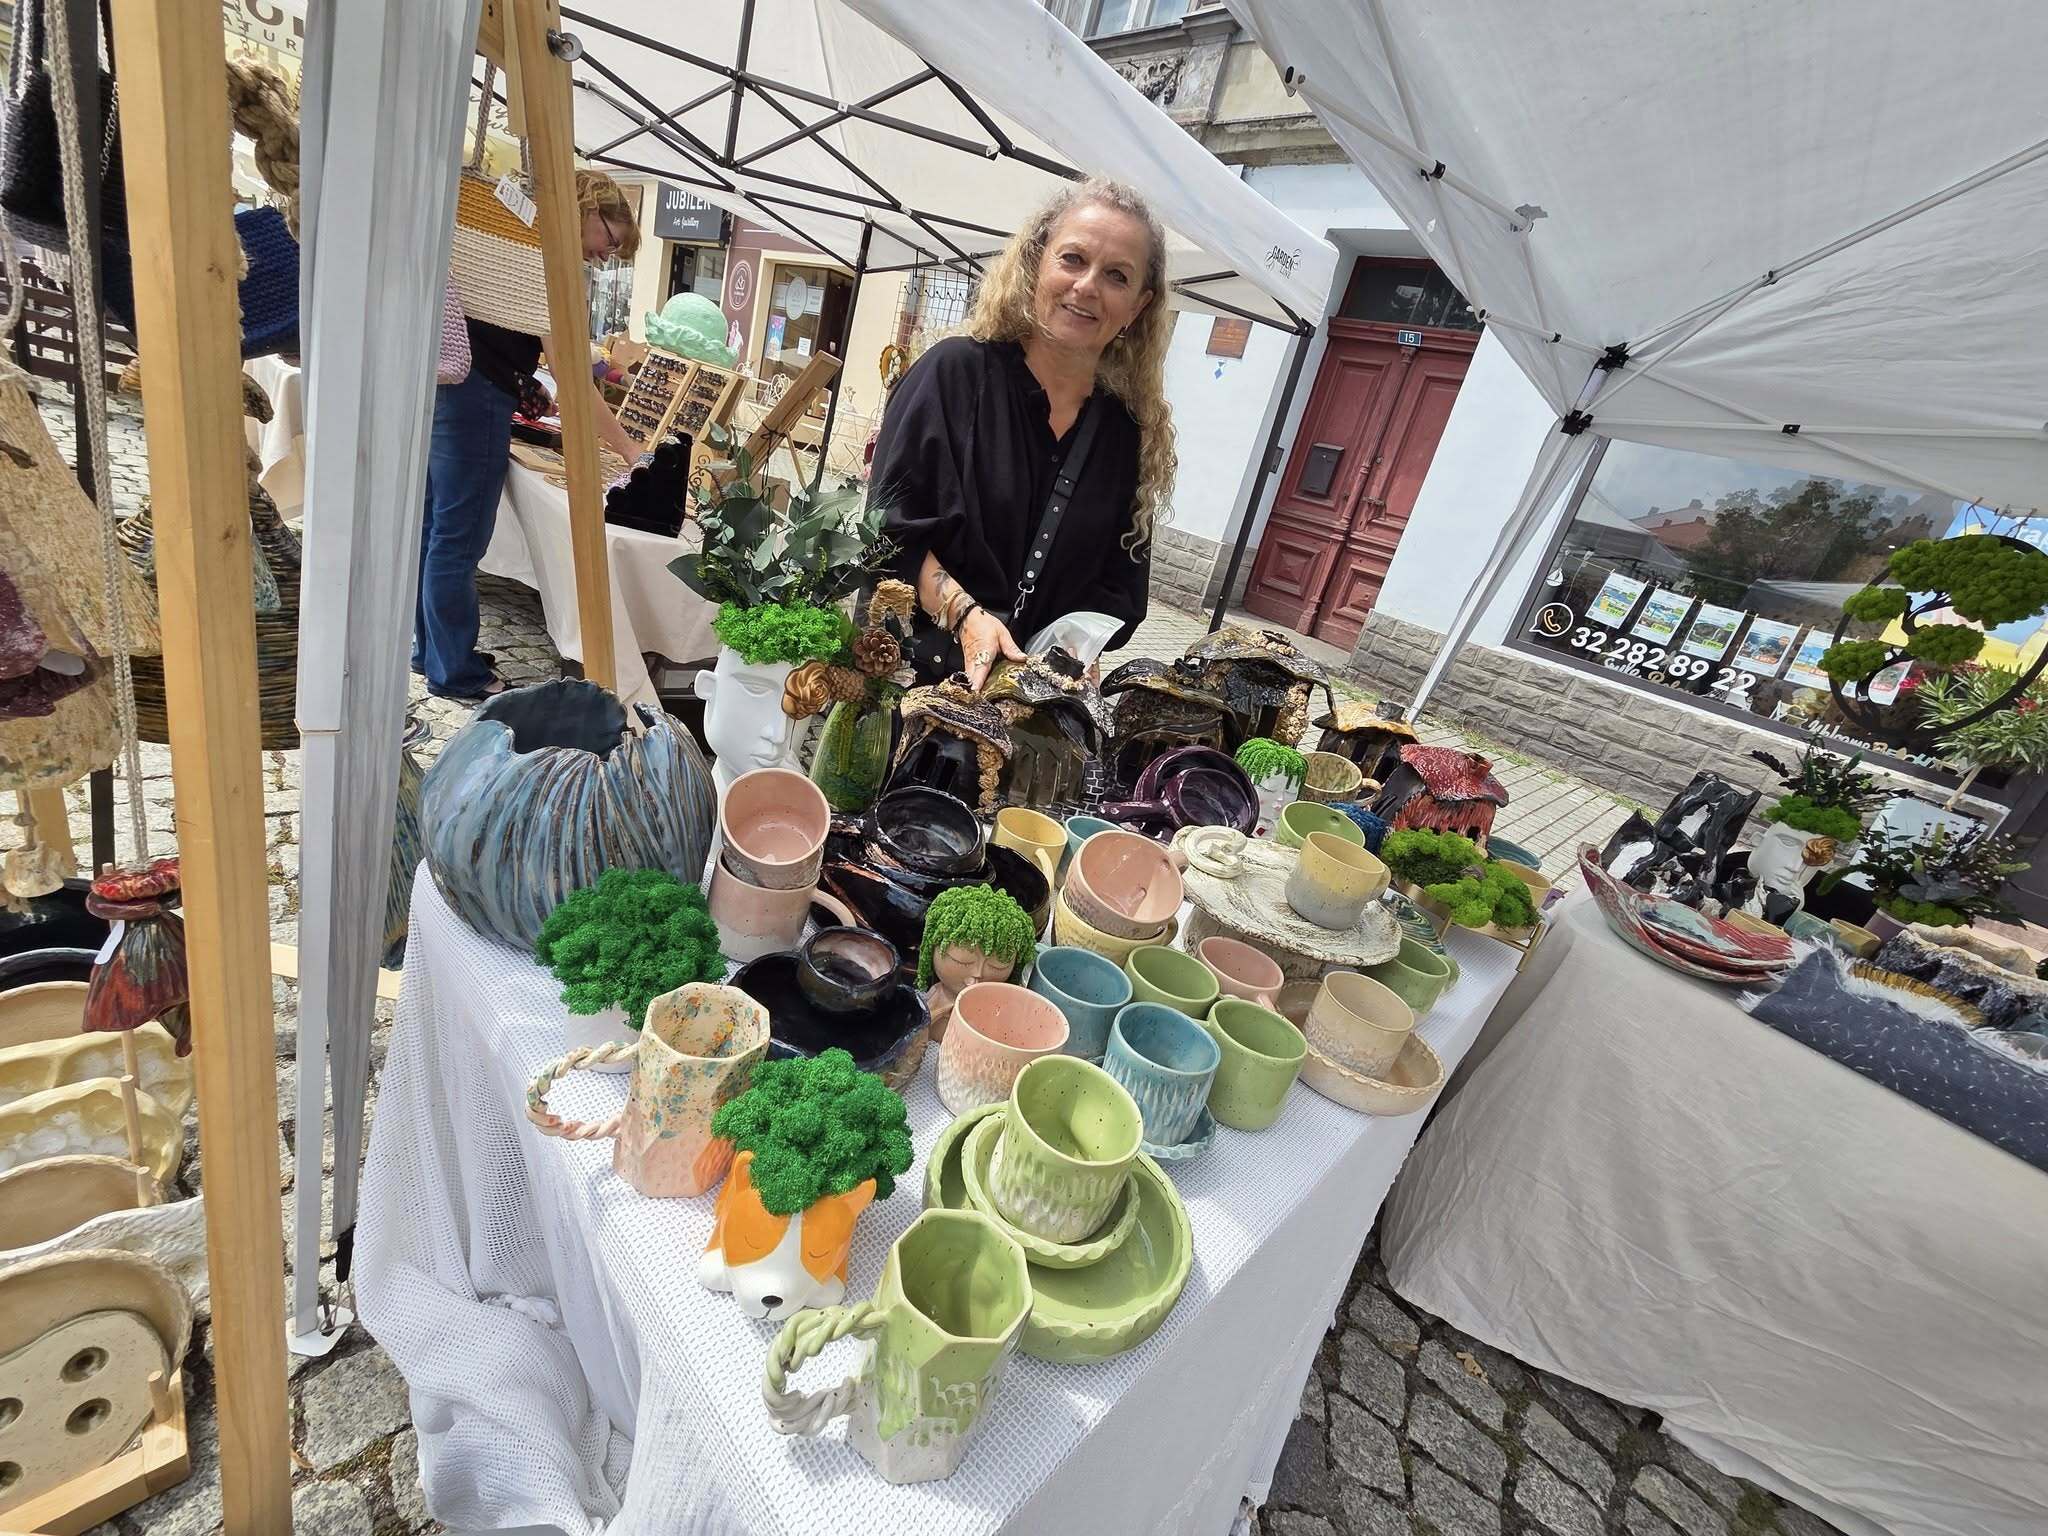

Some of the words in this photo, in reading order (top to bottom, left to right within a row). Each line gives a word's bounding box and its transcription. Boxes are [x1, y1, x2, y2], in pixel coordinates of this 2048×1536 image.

[1271, 245, 1294, 271] GARDEN
[1404, 332, 1415, 343] 15
[1571, 627, 1608, 653] 32
[1612, 640, 1666, 670] 282
[1668, 655, 1709, 681] 89
[1712, 668, 1757, 697] 22
